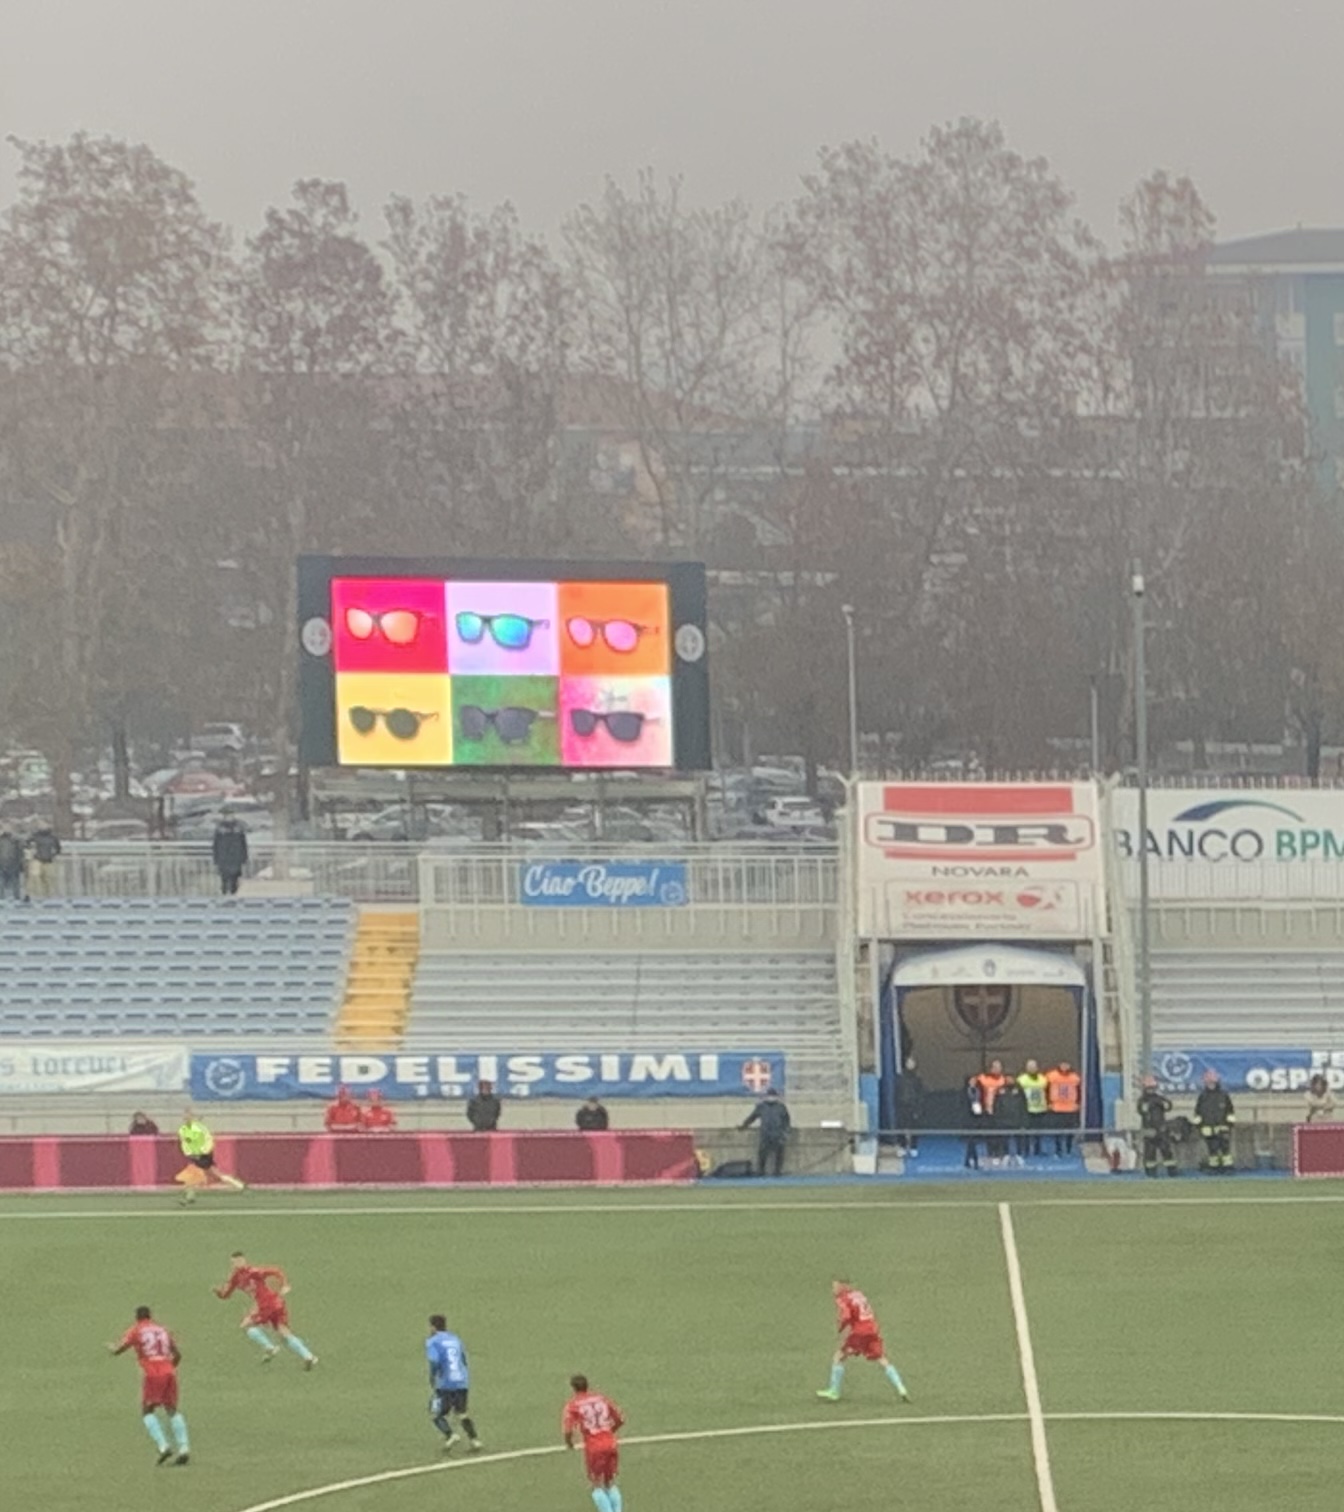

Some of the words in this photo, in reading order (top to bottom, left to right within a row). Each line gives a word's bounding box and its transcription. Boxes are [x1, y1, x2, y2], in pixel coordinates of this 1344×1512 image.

[1112, 828, 1263, 862] BANCO
[932, 866, 1030, 878] NOVARA
[524, 865, 577, 896] Ciao
[577, 865, 660, 903] Beppe!
[905, 889, 1005, 906] xerox
[256, 1055, 720, 1084] FEDELISSIMI
[412, 1083, 531, 1097] 194
